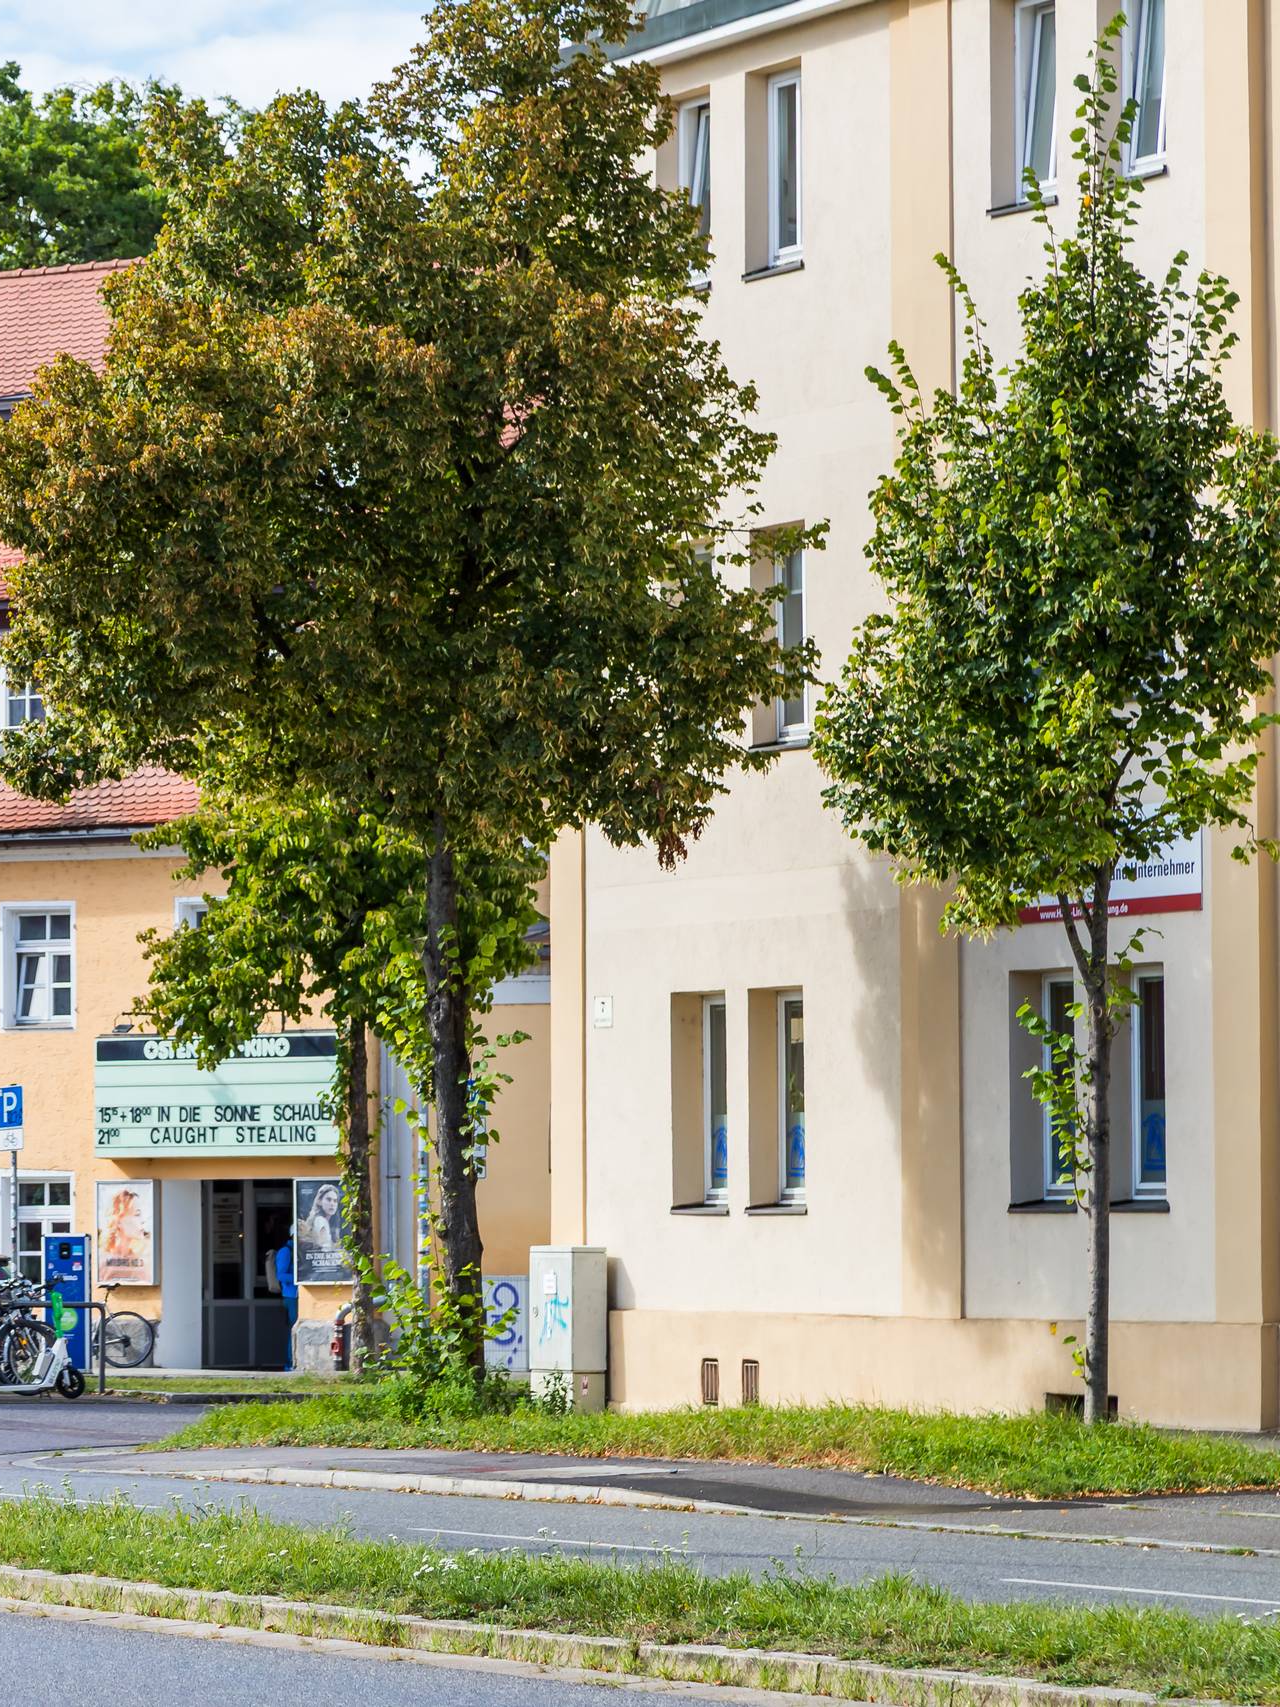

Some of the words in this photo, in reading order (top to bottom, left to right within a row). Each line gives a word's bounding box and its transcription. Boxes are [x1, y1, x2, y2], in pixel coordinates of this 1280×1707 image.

[3, 1091, 18, 1123] P
[157, 1105, 171, 1122] IN
[179, 1105, 201, 1122] DIE
[214, 1105, 261, 1122] SONNE
[150, 1126, 219, 1144] CAUGHT
[236, 1126, 316, 1143] STEALING
